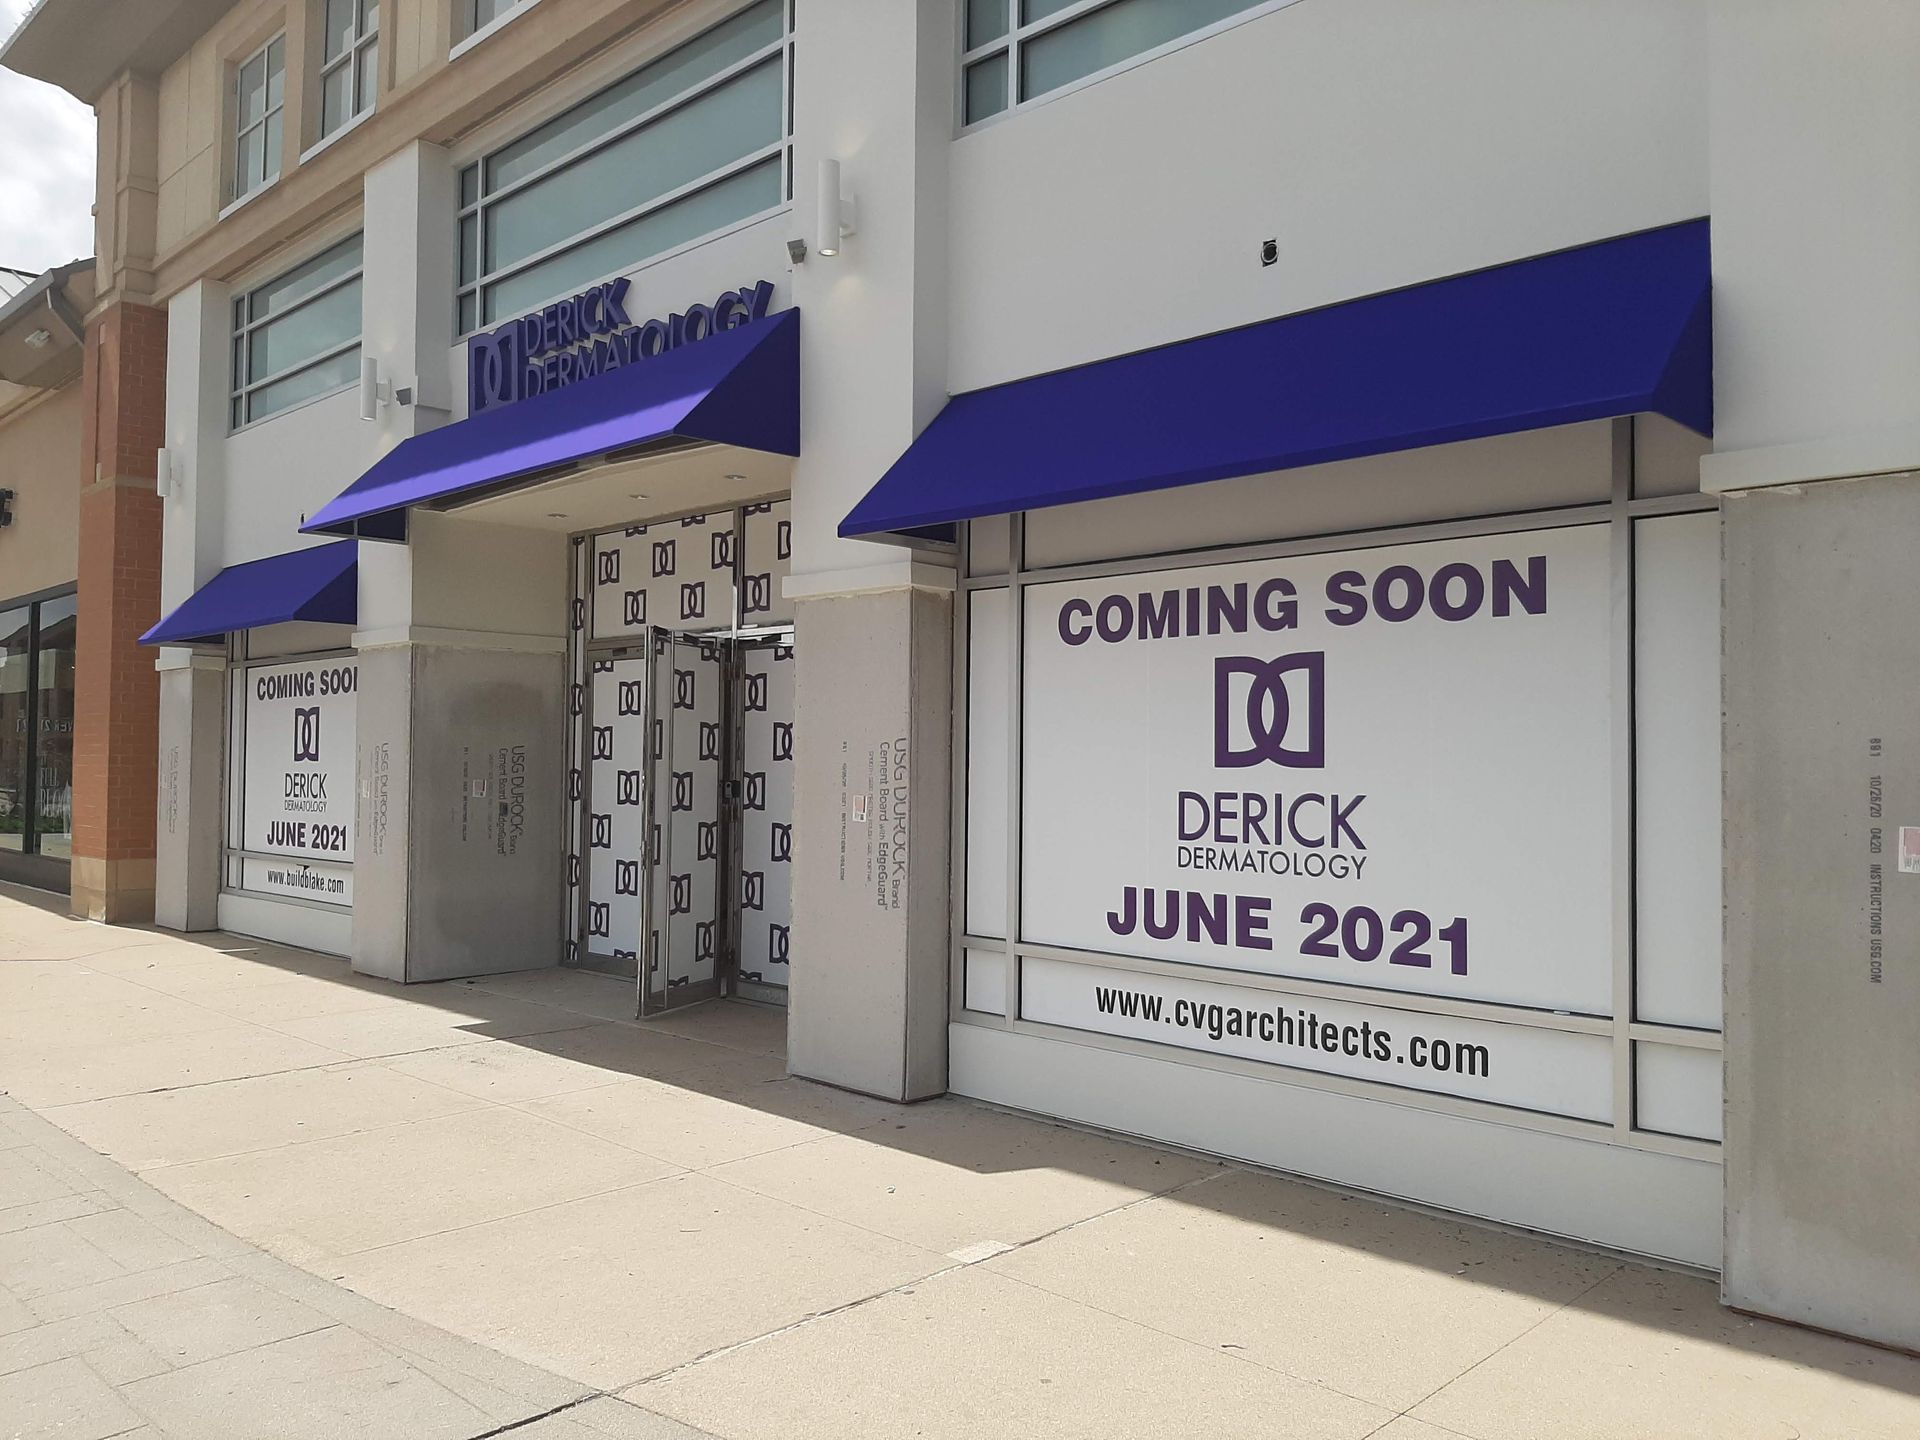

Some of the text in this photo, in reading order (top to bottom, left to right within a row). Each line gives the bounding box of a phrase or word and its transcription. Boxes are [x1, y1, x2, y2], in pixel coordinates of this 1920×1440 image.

[525, 277, 632, 356] DERICK
[525, 280, 775, 398] DERMATOLOGY
[1057, 555, 1547, 646] COMING SOON
[257, 666, 358, 701] COMING SOO
[511, 745, 525, 774] USG
[879, 741, 890, 785] Cement
[893, 737, 907, 781] USG
[284, 800, 327, 813] DERMATOLOGY
[285, 773, 327, 799] DERICK
[510, 776, 524, 836] DUROCK
[879, 787, 890, 822] Board
[267, 821, 346, 851] JUNE 2021
[1178, 791, 1367, 850] DERICK
[267, 869, 344, 894] www.buildblake.com
[1177, 846, 1367, 879] DERMATOLOGY
[1869, 863, 1882, 936] INSTRUCTIONS
[1107, 886, 1469, 976] JUNE 2021
[1869, 938, 1882, 984] USG.COM
[1095, 986, 1490, 1078] www.cvgarchitects.com
